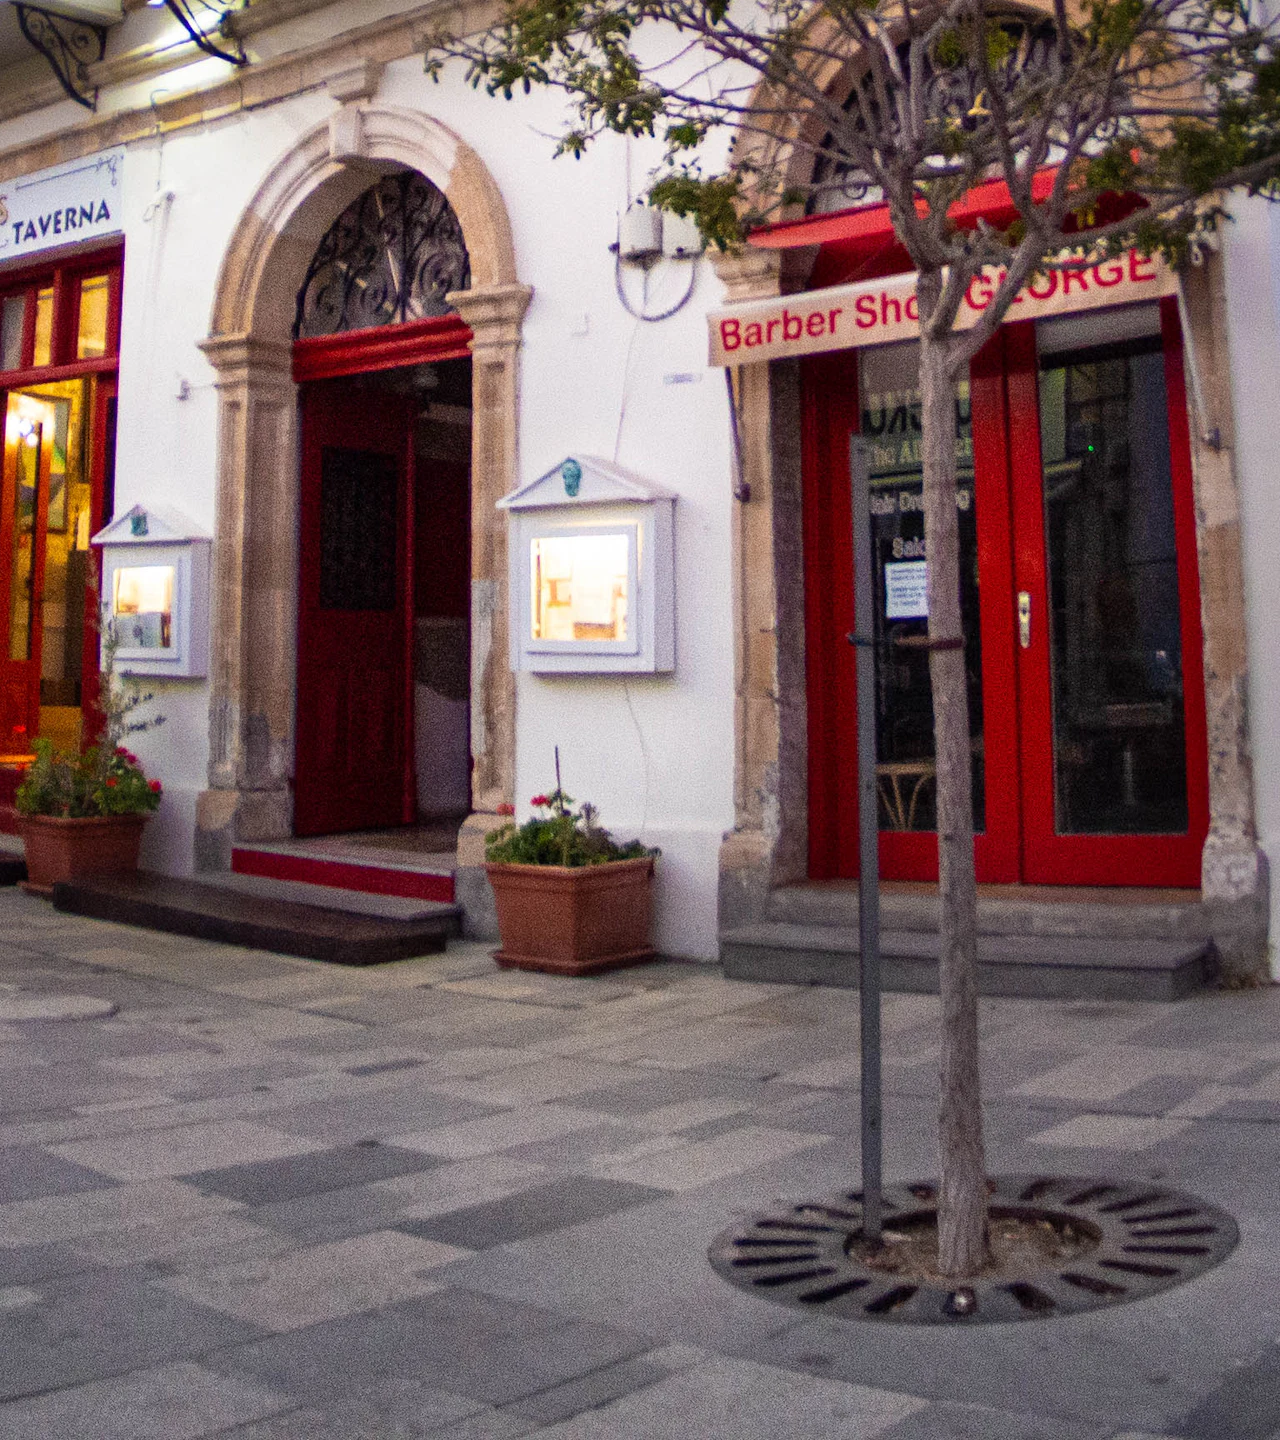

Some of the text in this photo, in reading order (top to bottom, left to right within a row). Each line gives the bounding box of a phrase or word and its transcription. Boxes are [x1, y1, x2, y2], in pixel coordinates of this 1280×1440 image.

[12, 198, 111, 245] TAVERNA
[719, 307, 842, 352] Barber
[853, 291, 921, 330] Sho
